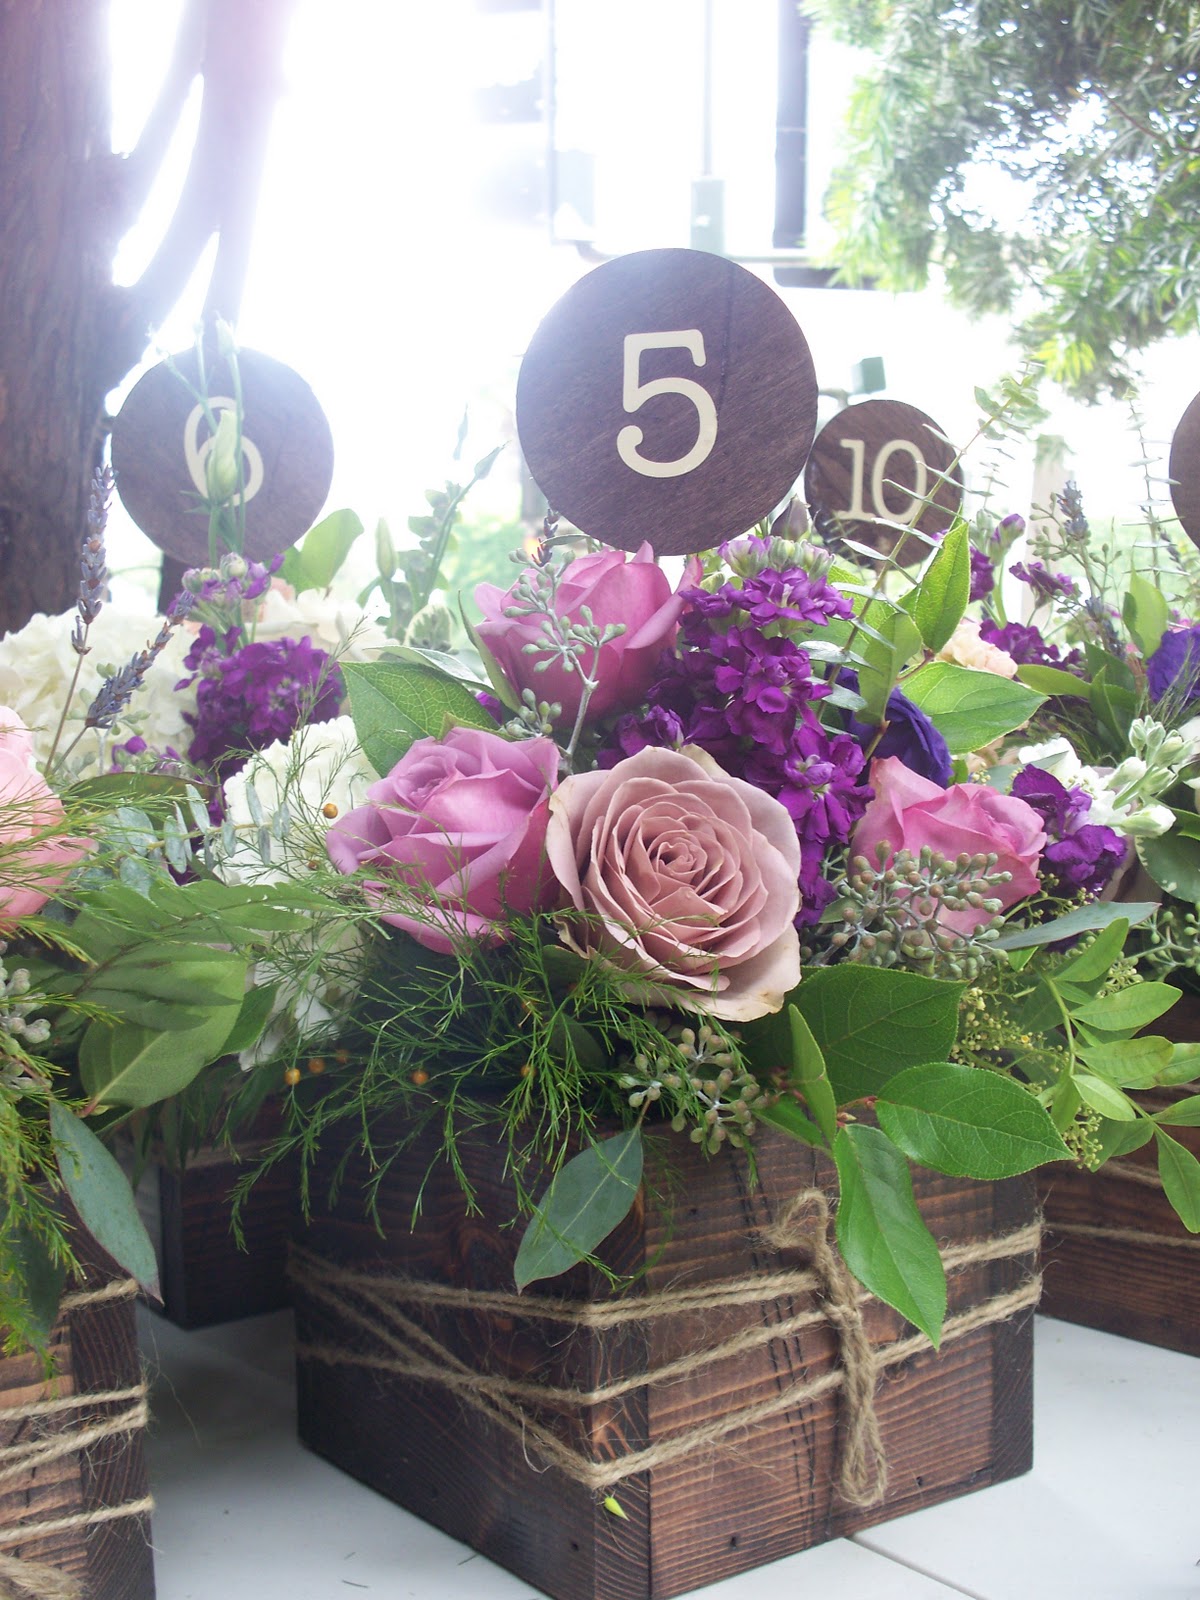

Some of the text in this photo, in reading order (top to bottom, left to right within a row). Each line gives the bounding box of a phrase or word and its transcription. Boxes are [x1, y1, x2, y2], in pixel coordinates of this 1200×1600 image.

[184, 396, 264, 507] 6
[617, 329, 717, 478] 5
[834, 439, 927, 524] 10
